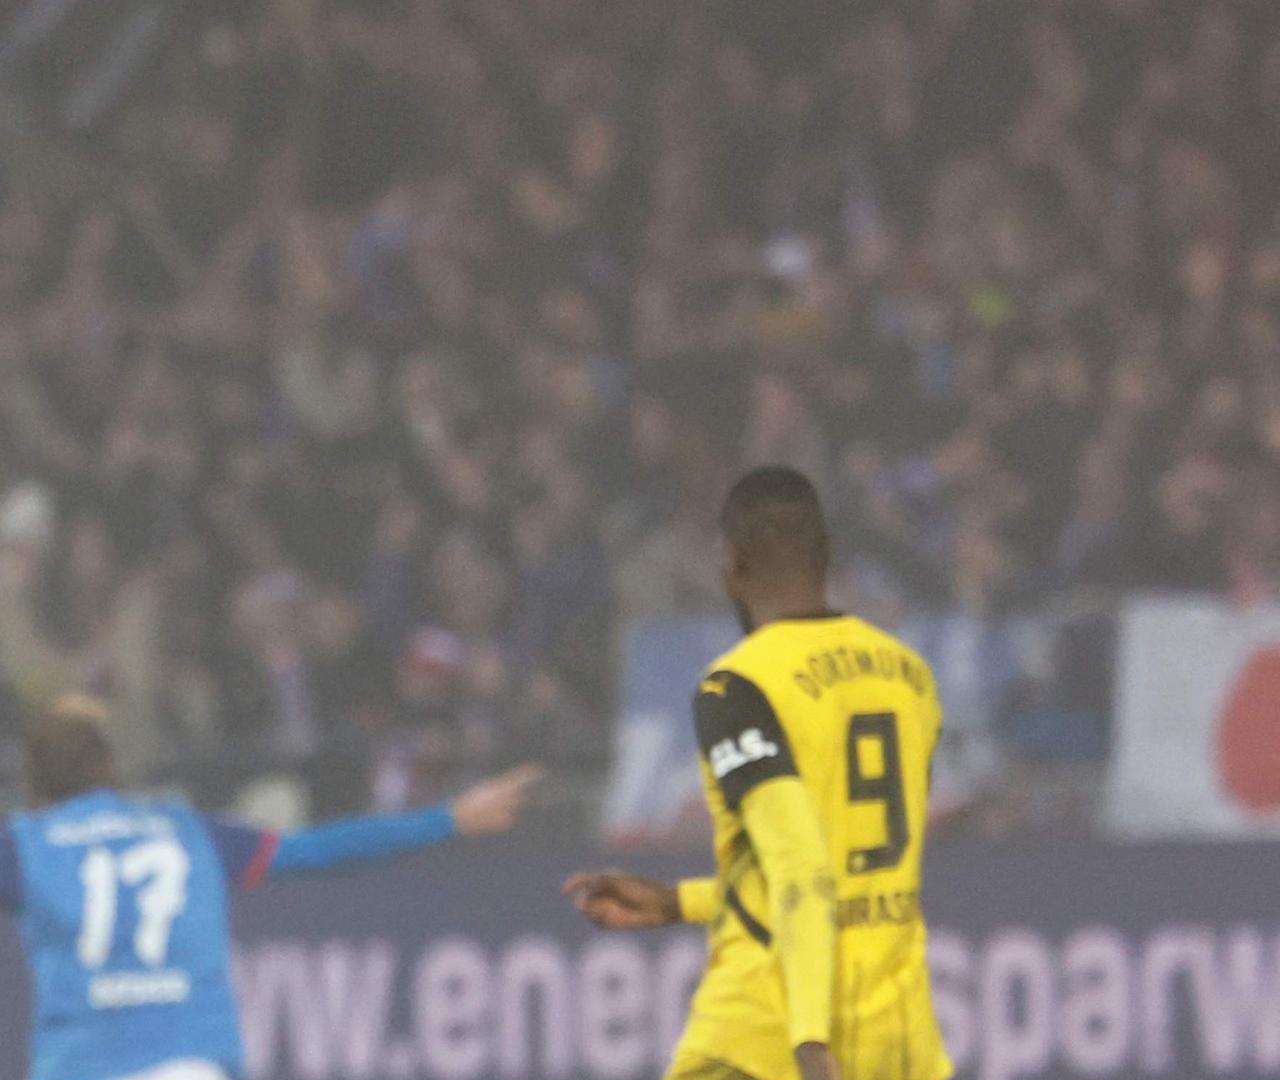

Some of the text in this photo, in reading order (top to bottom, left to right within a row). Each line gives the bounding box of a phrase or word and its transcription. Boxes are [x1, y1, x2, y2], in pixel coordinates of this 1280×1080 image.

[793, 646, 927, 701] DORTMUND
[846, 712, 910, 875] 9
[77, 838, 190, 970] 17
